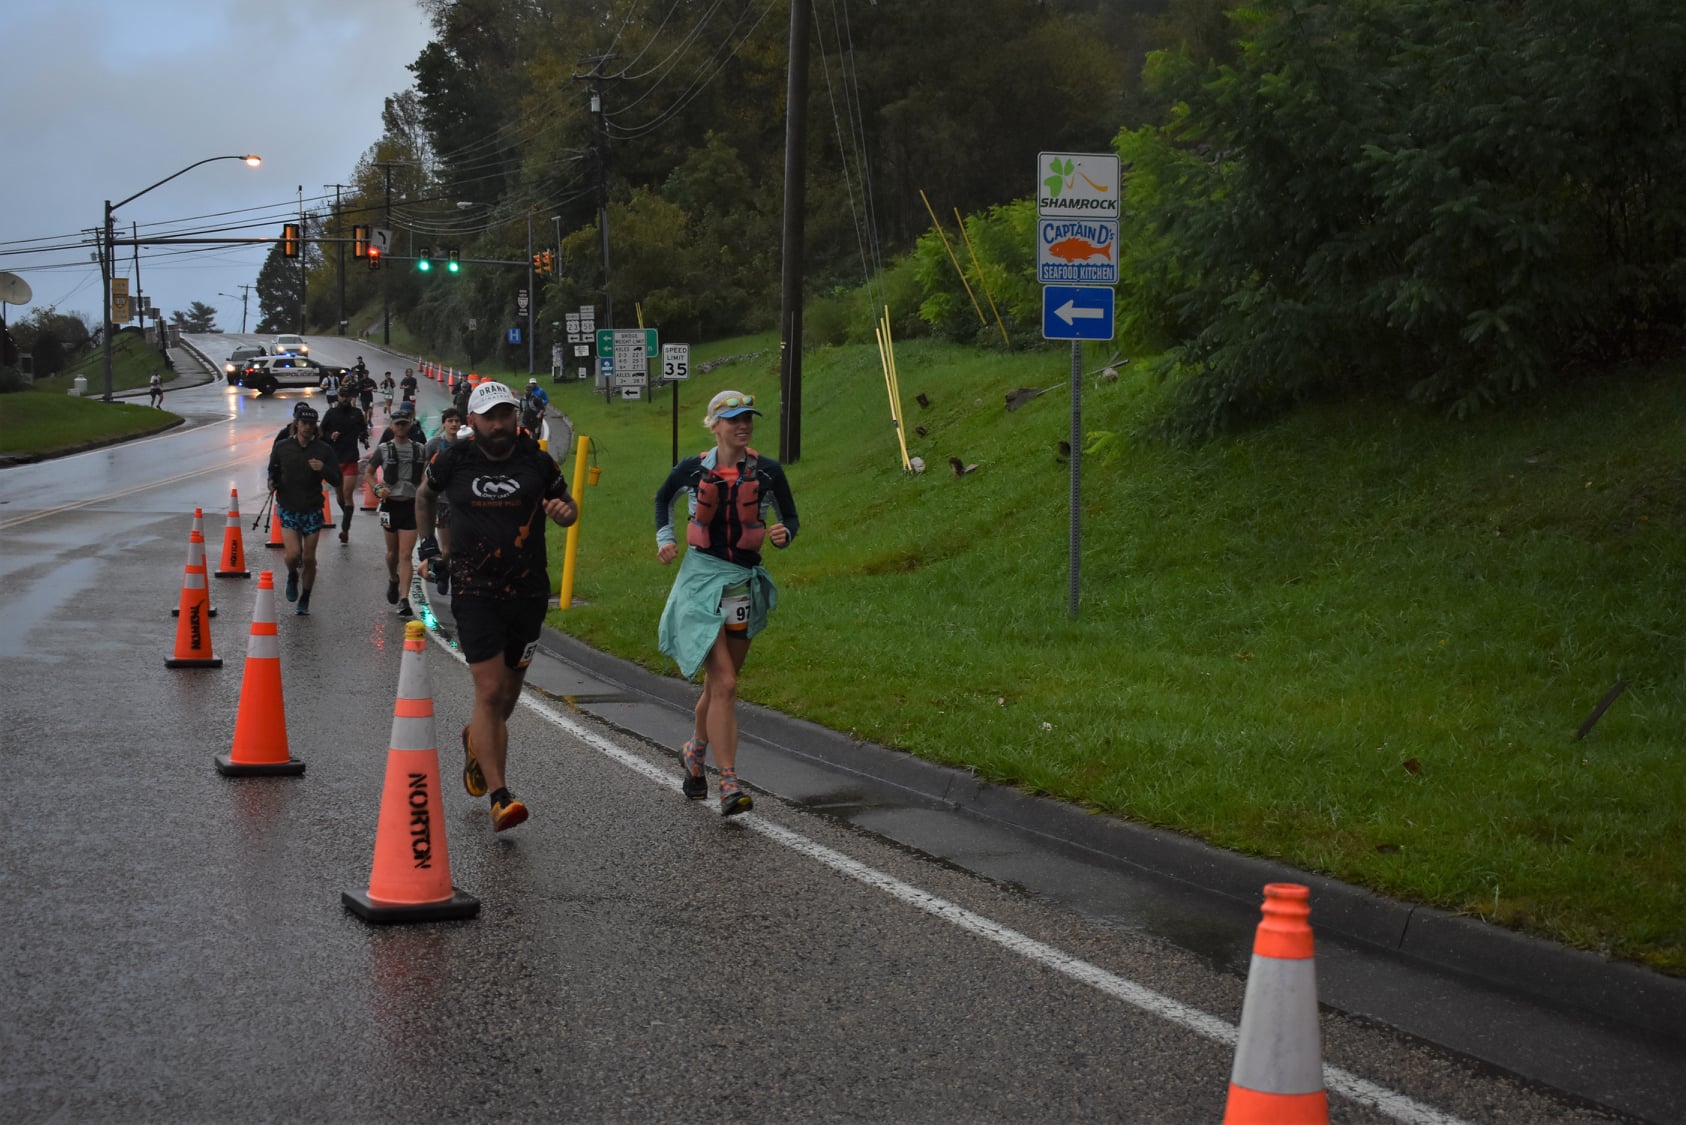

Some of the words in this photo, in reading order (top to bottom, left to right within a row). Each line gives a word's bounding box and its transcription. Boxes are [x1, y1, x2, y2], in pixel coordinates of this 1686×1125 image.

[1040, 198, 1117, 210] SHAMROCK
[1043, 223, 1096, 244] CAPTAIN
[1043, 266, 1078, 279] SEAFOOD
[1080, 267, 1113, 280] KITCHEN
[665, 363, 687, 376] 35
[408, 773, 432, 869] NORTON
